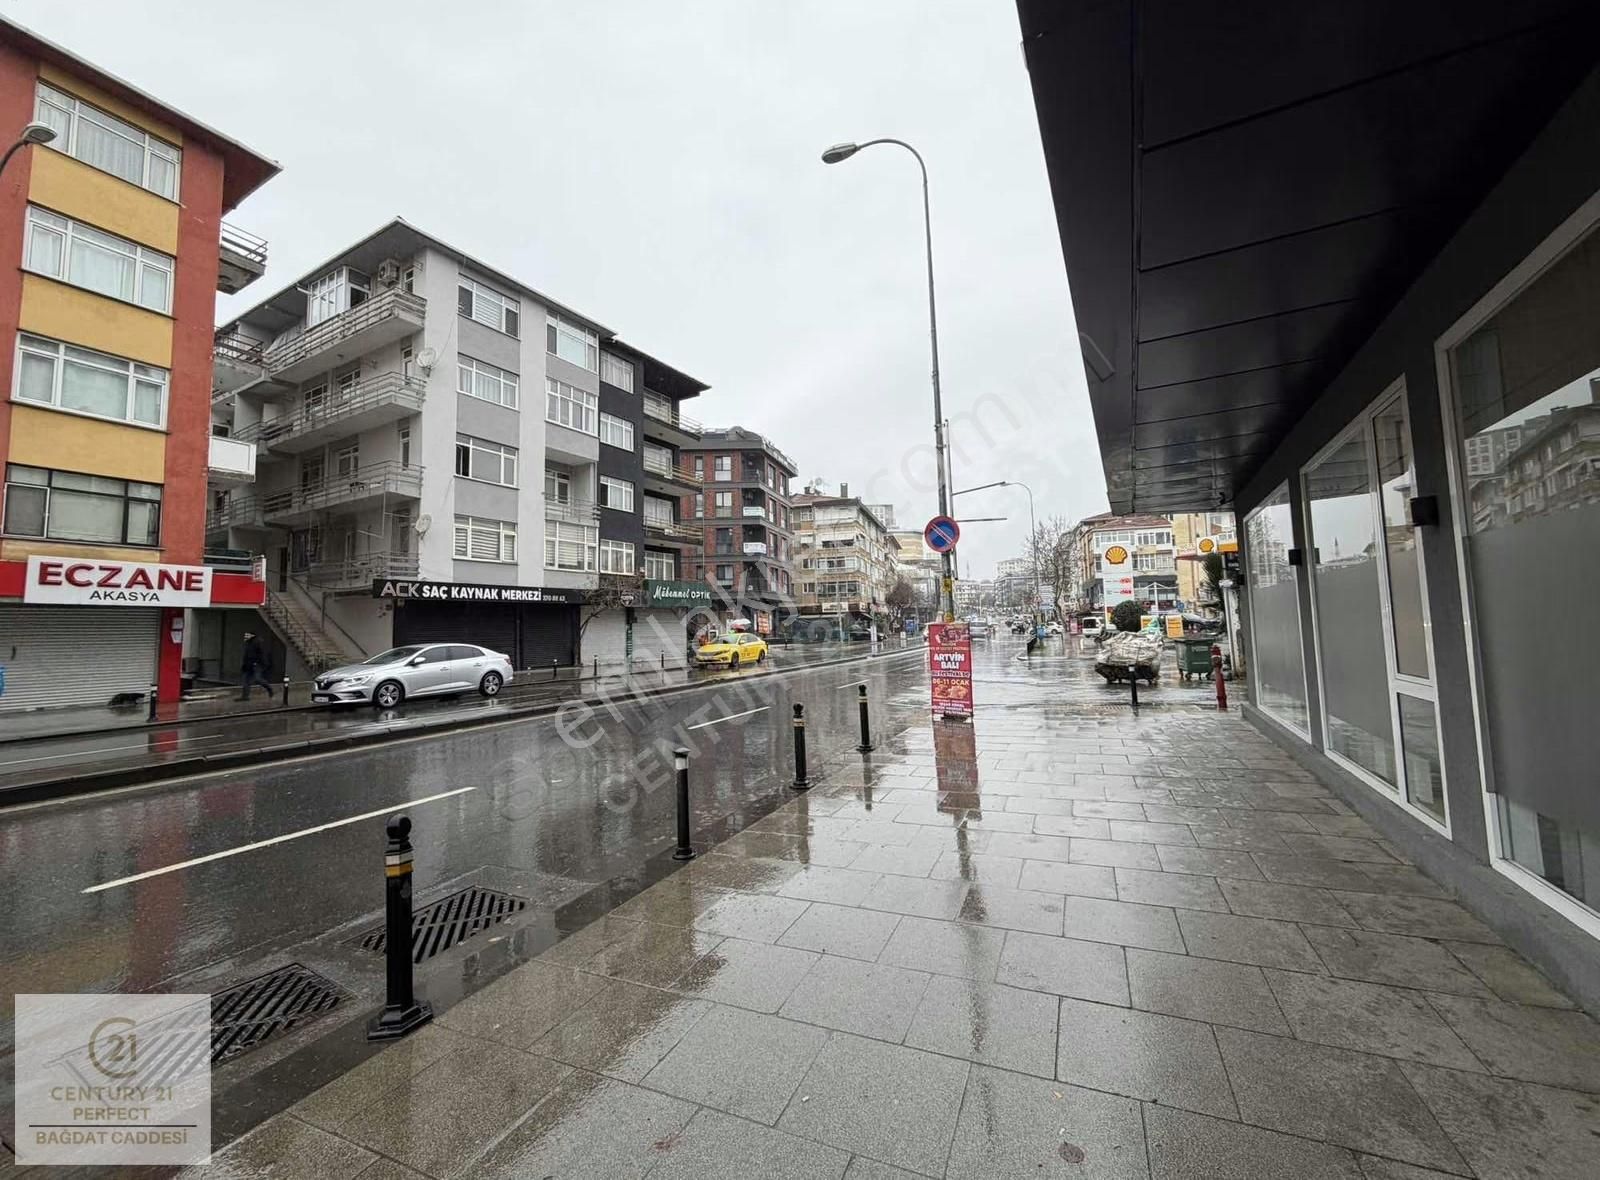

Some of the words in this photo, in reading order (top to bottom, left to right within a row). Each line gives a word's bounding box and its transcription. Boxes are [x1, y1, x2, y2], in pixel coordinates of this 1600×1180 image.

[38, 561, 204, 592] ECZANE
[89, 590, 161, 602] AKASYA
[380, 581, 419, 598] ACK
[421, 584, 448, 600] SAÇ
[451, 587, 499, 600] KAYNAK
[501, 588, 542, 601] MERKEZİ
[653, 584, 690, 600] Mükemmel
[934, 652, 965, 662] ARTVİN
